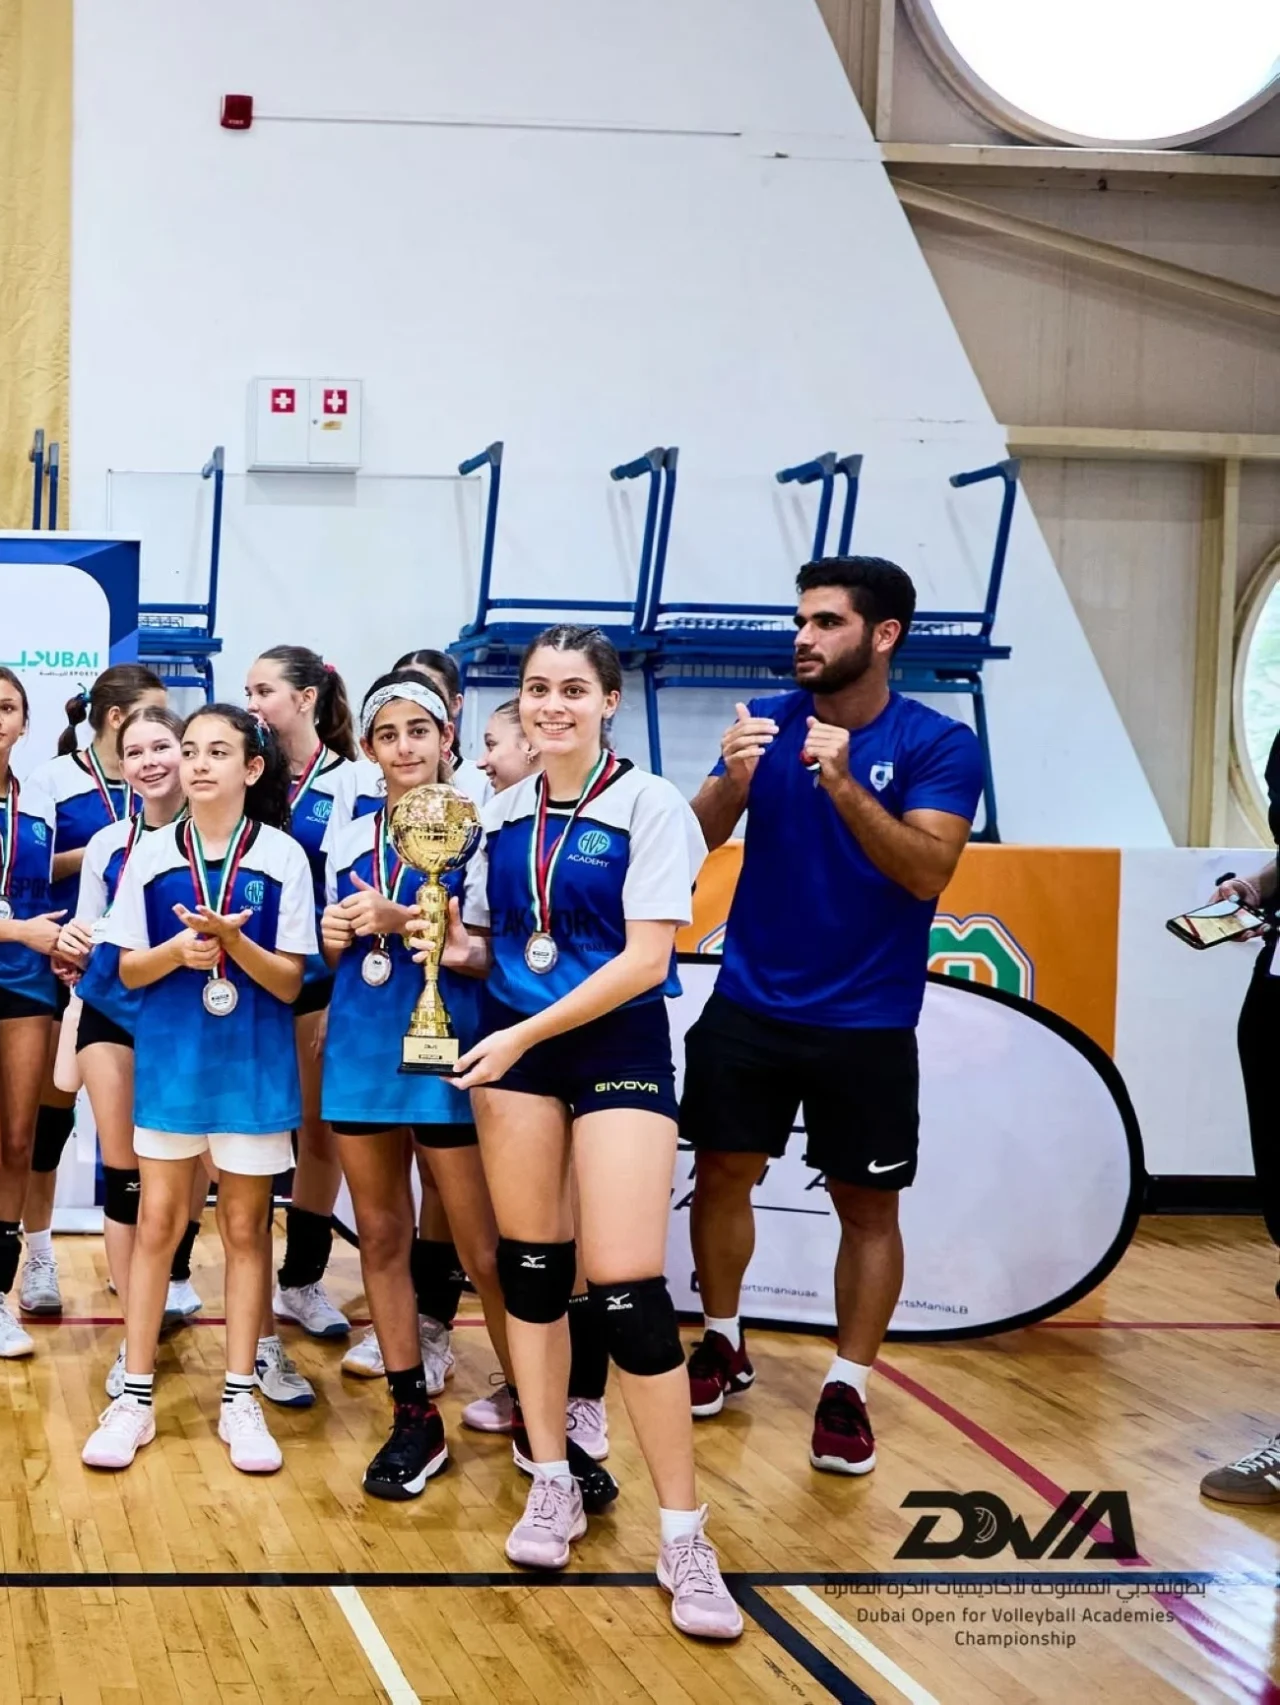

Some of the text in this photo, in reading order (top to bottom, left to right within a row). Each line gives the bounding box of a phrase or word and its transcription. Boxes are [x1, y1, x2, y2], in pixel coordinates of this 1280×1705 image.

[579, 832, 609, 855] HVS
[566, 853, 610, 868] ACADEMY
[595, 1080, 658, 1094] GIVOVA
